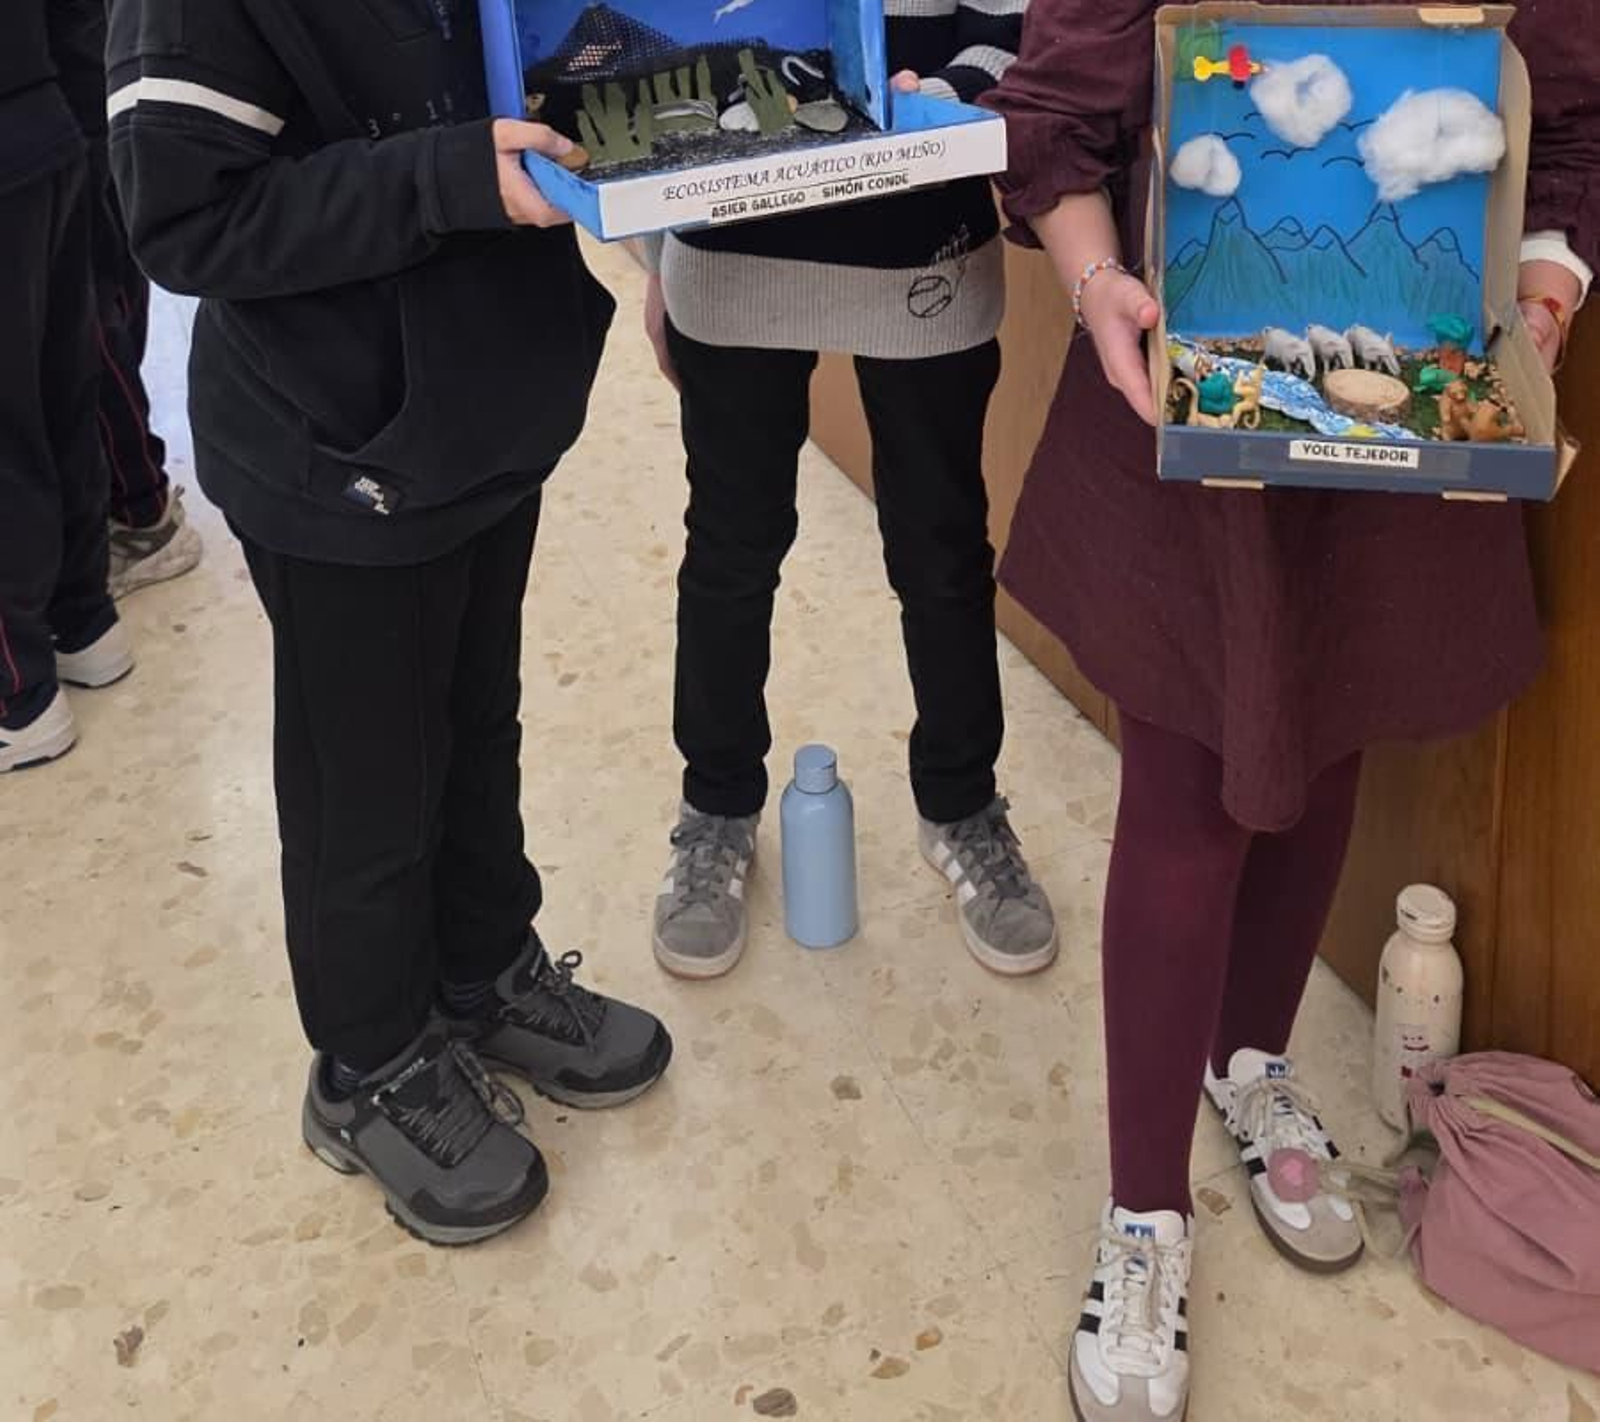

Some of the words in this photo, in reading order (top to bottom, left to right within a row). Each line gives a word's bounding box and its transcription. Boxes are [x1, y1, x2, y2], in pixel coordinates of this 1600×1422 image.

[663, 170, 770, 201] ECOSISTEMA
[897, 139, 946, 161] MIÑO)
[711, 201, 747, 219] ASIER
[752, 191, 806, 211] GALLEGO
[822, 181, 863, 198] SIMÓN
[868, 173, 909, 191] CONDE
[1302, 443, 1339, 458] YOEL
[1345, 447, 1409, 463] TEJEDOR
